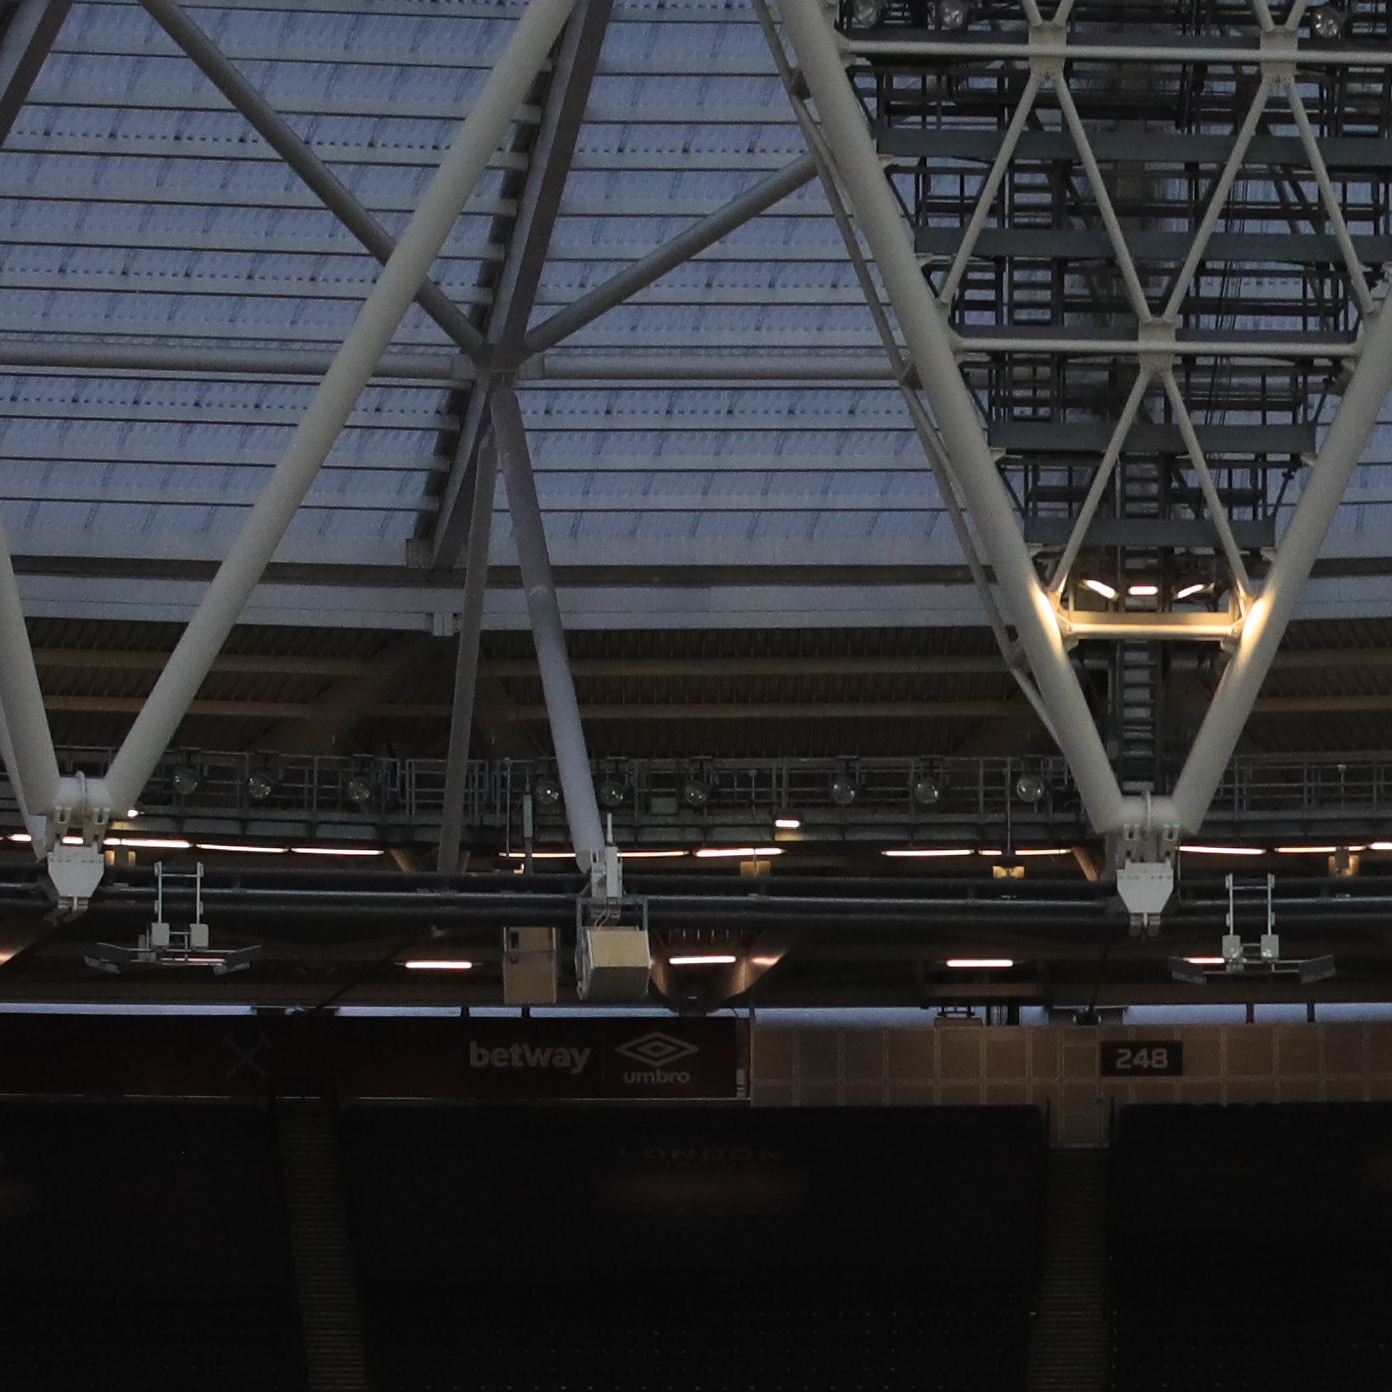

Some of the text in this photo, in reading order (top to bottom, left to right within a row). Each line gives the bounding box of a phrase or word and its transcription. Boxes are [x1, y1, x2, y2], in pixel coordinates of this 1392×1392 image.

[469, 1040, 591, 1074] betway
[1115, 1047, 1169, 1071] 248
[622, 1069, 691, 1084] umbro
